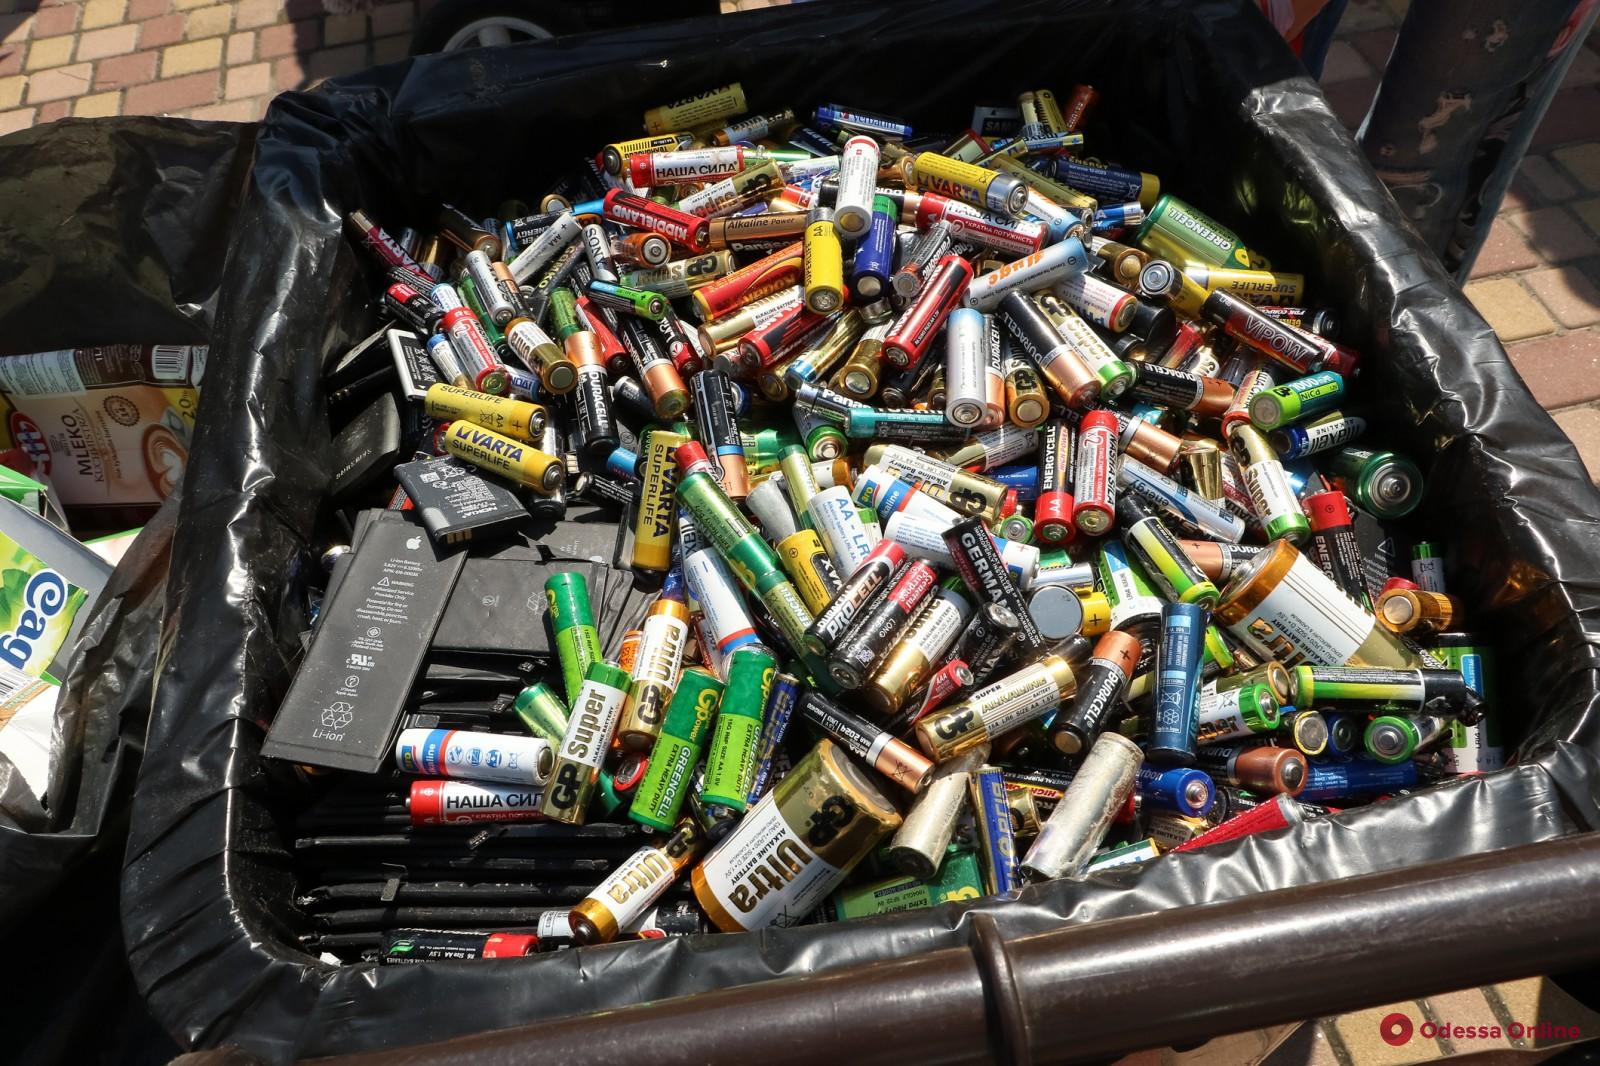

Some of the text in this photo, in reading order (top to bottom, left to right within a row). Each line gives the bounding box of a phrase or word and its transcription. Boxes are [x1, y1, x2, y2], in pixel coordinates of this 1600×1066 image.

[655, 161, 738, 178] НАША СИЛА
[929, 175, 981, 202] VARTA
[727, 217, 795, 230] Alkaline Power
[813, 225, 824, 237] AA
[1169, 207, 1233, 250] GREENCELL
[585, 227, 607, 267] SONY
[1231, 280, 1297, 294] SUPERLIFE
[1004, 312, 1043, 365] DURACELL
[1244, 315, 1307, 362] VIPOW
[440, 384, 503, 404] SUPERLIFE
[588, 371, 608, 431] DURACELL
[1301, 388, 1321, 400] NiCd
[495, 413, 505, 428] AA
[61, 414, 93, 476] MLEKO
[452, 438, 511, 471] SUPERLIFE
[471, 427, 524, 462] VARTA
[1043, 425, 1056, 490] ENERGYCELL
[642, 444, 664, 525] SUPERLIFE
[888, 460, 949, 486] Alkaline Battery
[1104, 433, 1118, 506] NASHA SILA
[652, 470, 677, 538] VARTA
[861, 486, 874, 504] aro
[881, 489, 900, 520] lkaline
[950, 487, 987, 513] GP
[1049, 499, 1060, 513] AA
[1127, 477, 1170, 509] energy
[1241, 467, 1277, 518] Super
[472, 505, 499, 517] NOKIA
[834, 494, 872, 559] AA LR
[826, 572, 884, 641] PROCELL
[903, 575, 934, 609] General
[879, 617, 897, 638] LONG
[1271, 617, 1300, 644] BATTERY
[1294, 625, 1307, 639] SIZE
[648, 624, 681, 680] Ultra
[638, 685, 664, 725] GP
[974, 684, 1003, 700] SUPER
[981, 676, 1048, 714] ALKALINE
[1032, 686, 1051, 699] BATTERY
[1083, 671, 1119, 725] DURACELL
[567, 688, 606, 759] Super
[934, 706, 975, 741] GP
[1001, 714, 1015, 725] LR6
[1015, 707, 1030, 718] SIZE
[1030, 702, 1040, 712] AA
[312, 728, 346, 742] Li-ion
[592, 705, 615, 763] ALKALINE BATTERY
[743, 723, 753, 747] EXTRA
[839, 724, 871, 747] MAR 2024
[647, 743, 680, 812] EXTRA HEAVY DUTY
[717, 761, 724, 771] AA
[741, 725, 761, 800] GREENCELL
[1137, 769, 1162, 781] arbon
[552, 763, 583, 810] GP
[655, 746, 692, 819] GREENCELL
[734, 774, 743, 794] DUTY
[1030, 787, 1056, 797] HIGH
[447, 793, 543, 809] НАША СИЛ
[807, 795, 855, 847] GP
[730, 827, 787, 886] ALKALINE BATTERY
[739, 849, 753, 861] SIZE
[606, 853, 670, 905] Ultra
[727, 838, 815, 914] Ultra
[910, 898, 928, 910] Extra
